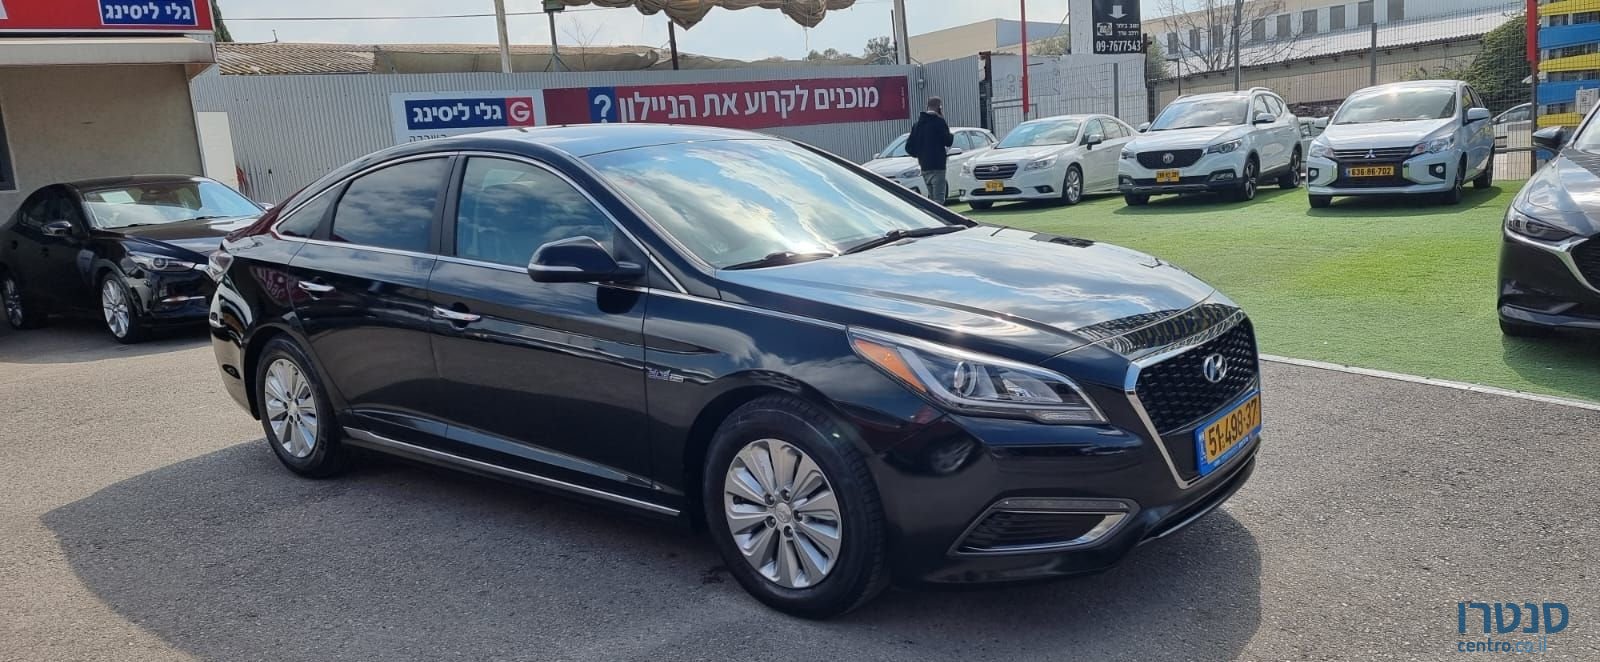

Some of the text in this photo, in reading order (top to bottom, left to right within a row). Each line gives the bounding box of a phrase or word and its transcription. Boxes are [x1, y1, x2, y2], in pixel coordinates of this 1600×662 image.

[105, 2, 191, 20] גלי ליסינג
[1096, 40, 1141, 52] 09-7677543
[618, 91, 697, 123] הניילון
[702, 92, 739, 116] את
[744, 84, 809, 119] לקרוע
[814, 86, 880, 110] מוכנים
[413, 101, 530, 123] G גלי ליסינג
